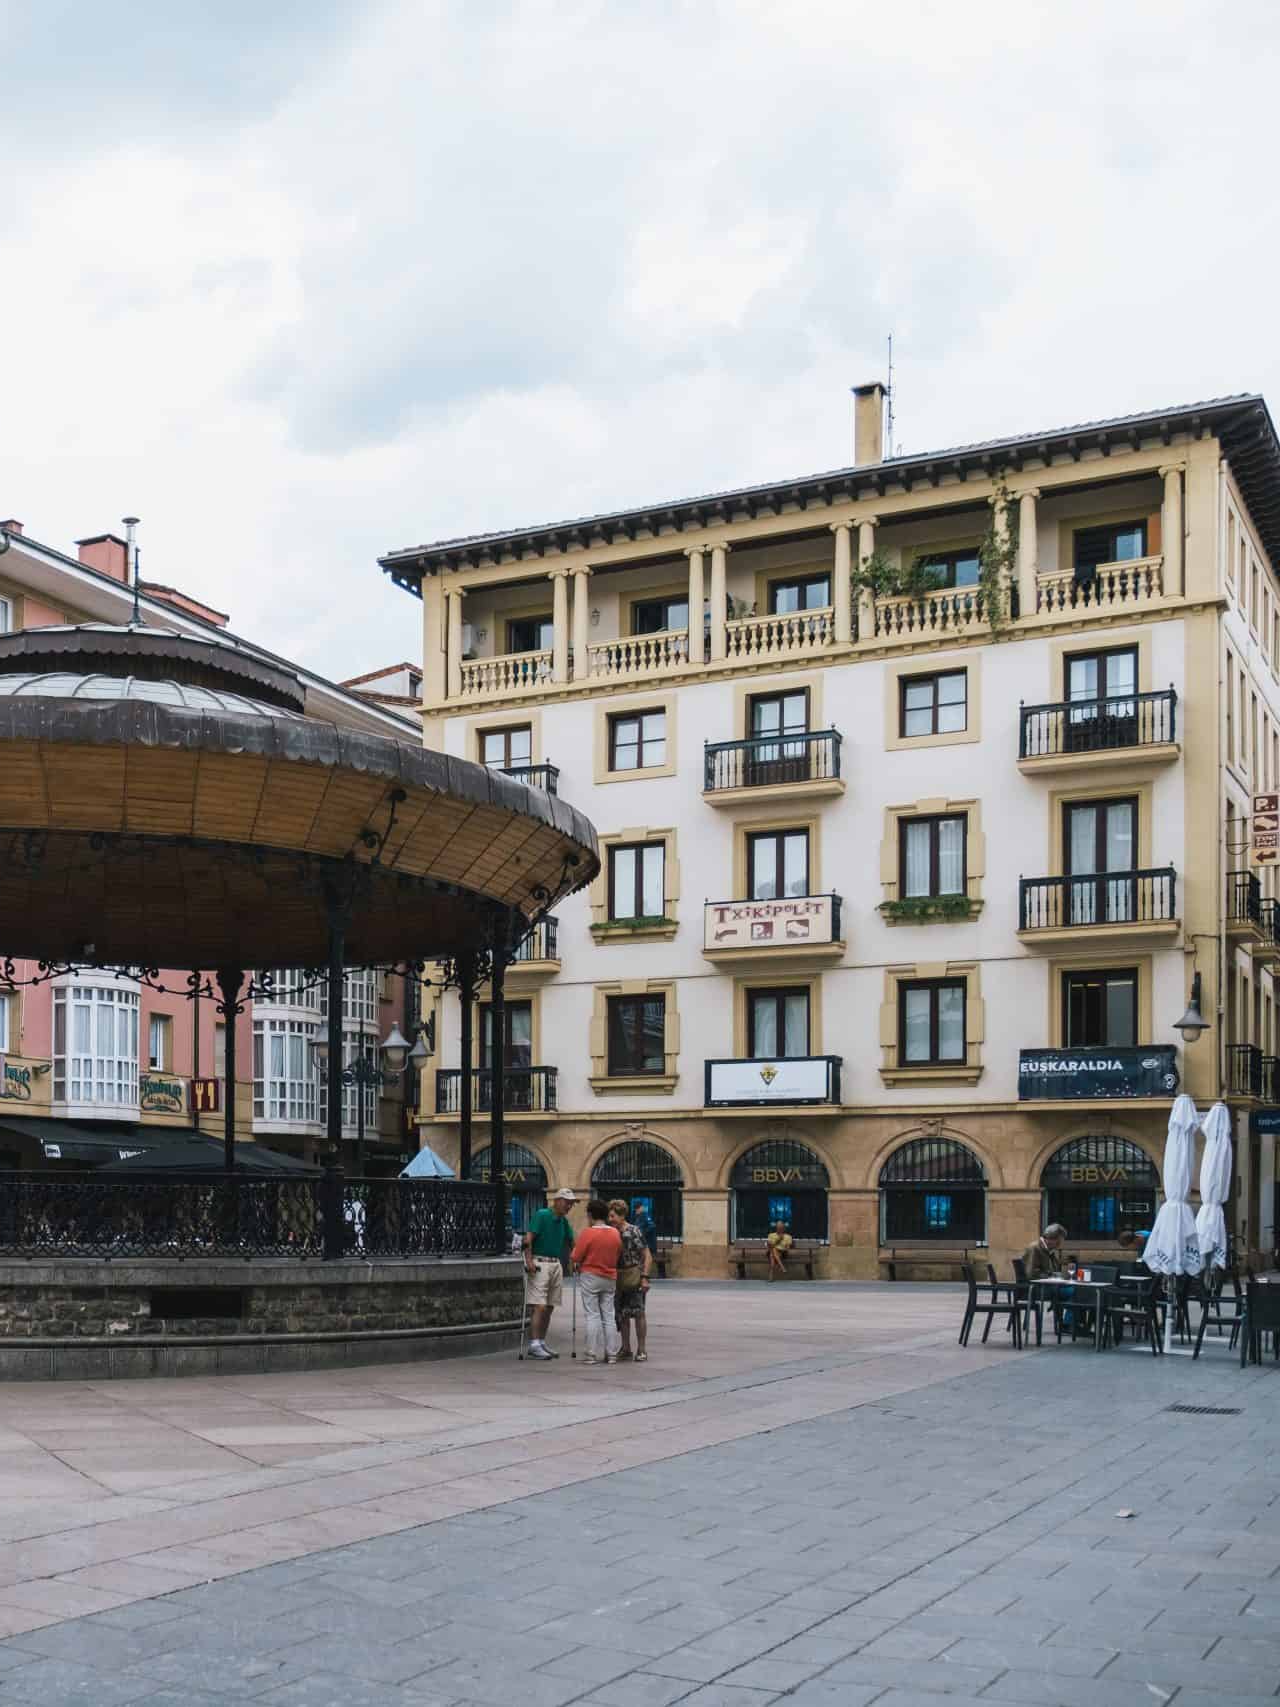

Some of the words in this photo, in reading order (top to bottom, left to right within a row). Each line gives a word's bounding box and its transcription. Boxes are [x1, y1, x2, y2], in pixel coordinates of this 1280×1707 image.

[1020, 1060, 1124, 1073] EUSKARALDIA
[752, 1168, 803, 1183] BBVA
[1071, 1168, 1129, 1182] BBVA
